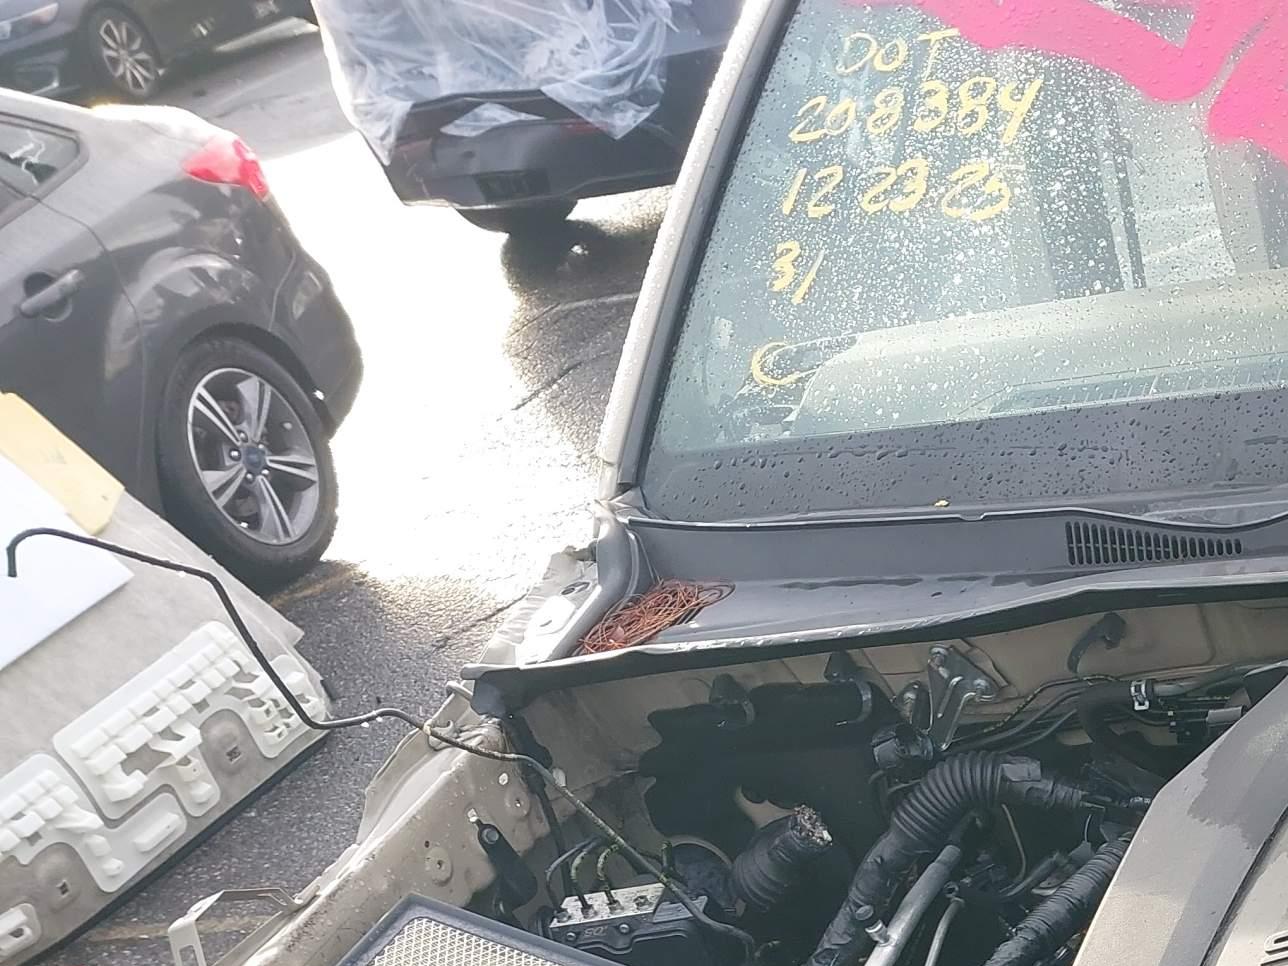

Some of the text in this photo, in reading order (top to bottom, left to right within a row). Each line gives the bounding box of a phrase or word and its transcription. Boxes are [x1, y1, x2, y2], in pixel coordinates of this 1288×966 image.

[836, 28, 960, 82] DOT
[782, 165, 844, 219] 12
[858, 158, 930, 216] 23
